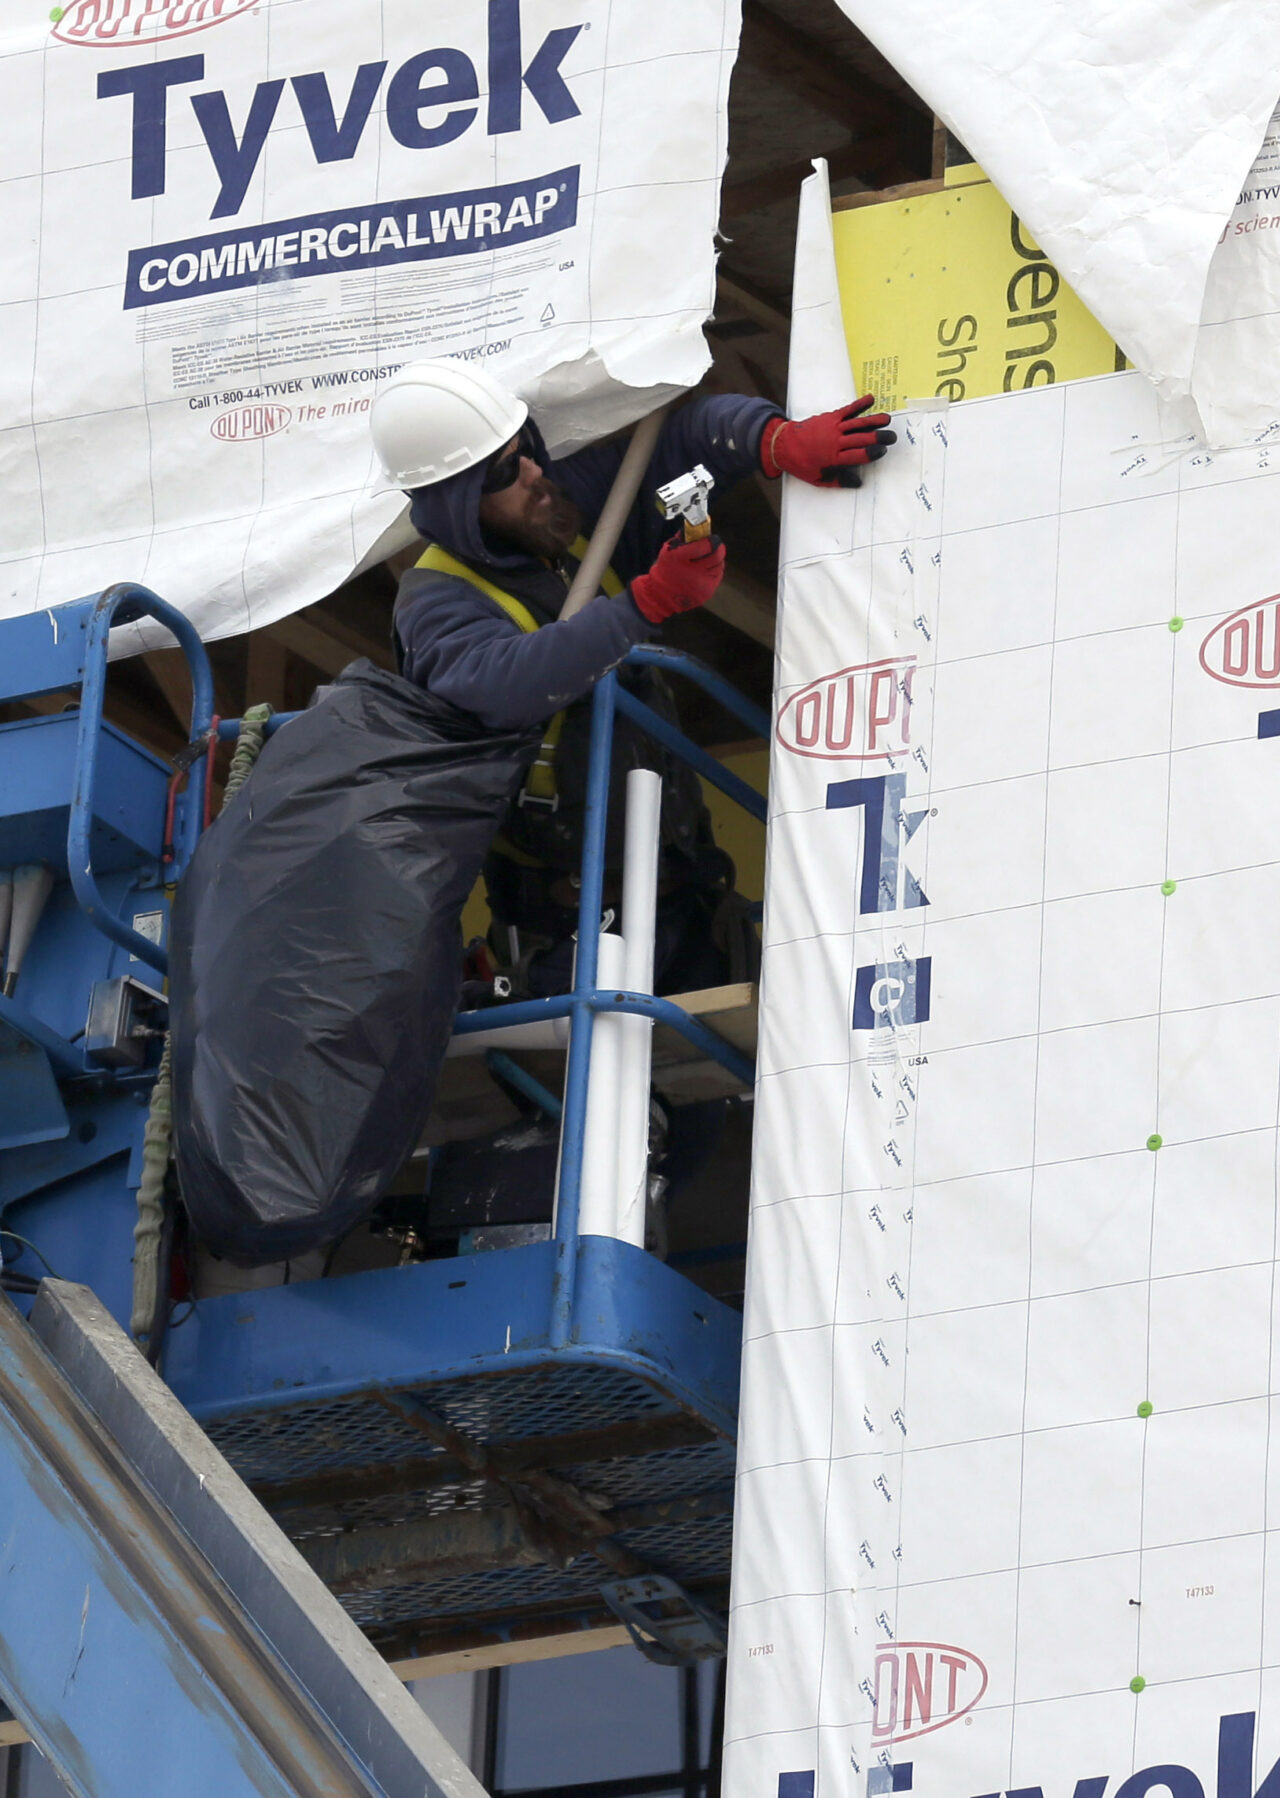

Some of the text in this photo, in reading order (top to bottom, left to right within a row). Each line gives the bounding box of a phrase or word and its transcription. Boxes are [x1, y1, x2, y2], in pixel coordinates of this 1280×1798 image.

[97, 0, 583, 220] Tyvek
[138, 187, 560, 293] COMMERCIALWRAP
[559, 260, 575, 272] USA
[188, 397, 211, 410] Call
[212, 380, 303, 405] 1-800-44-TYVEK
[298, 405, 325, 423] The
[331, 398, 374, 418] mira
[908, 1056, 928, 1067] USA
